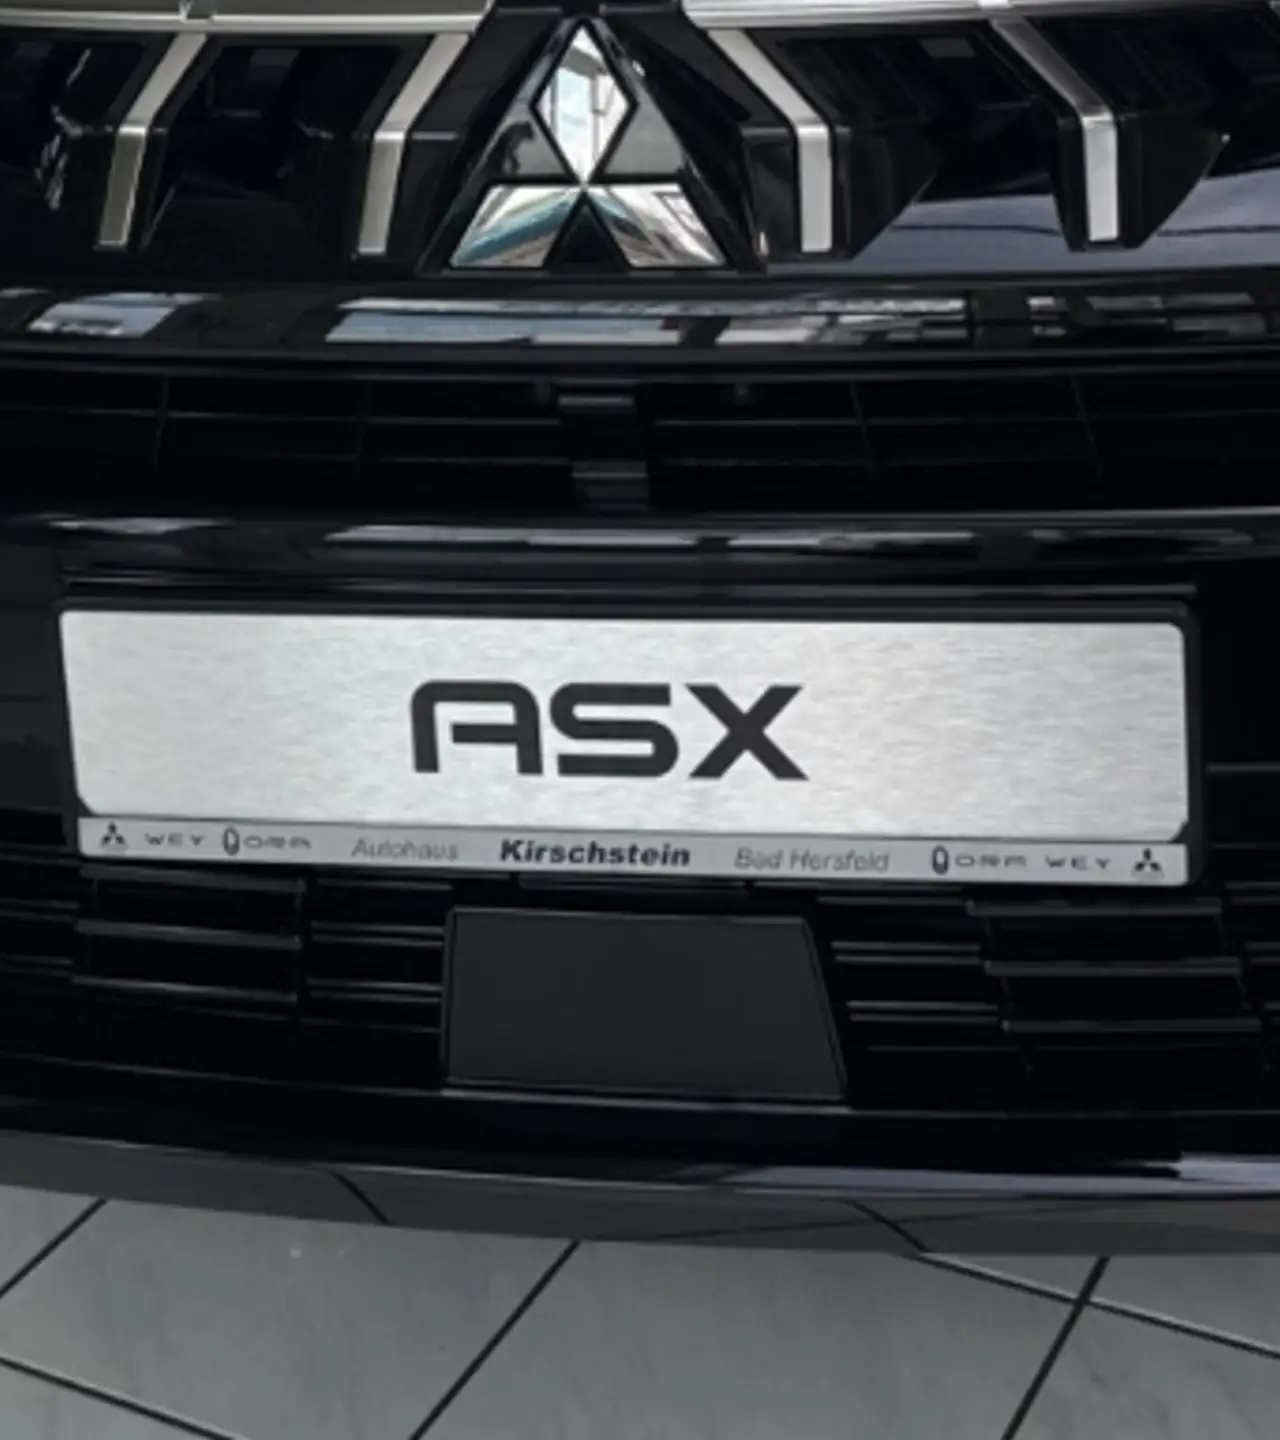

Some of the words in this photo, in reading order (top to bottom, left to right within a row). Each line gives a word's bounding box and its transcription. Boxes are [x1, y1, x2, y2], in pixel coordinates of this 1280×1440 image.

[411, 679, 809, 781] ASX
[351, 837, 460, 861] Autohaus
[500, 838, 691, 869] Kirschstein
[733, 846, 782, 871] Bad
[789, 848, 891, 874] Hersfeld
